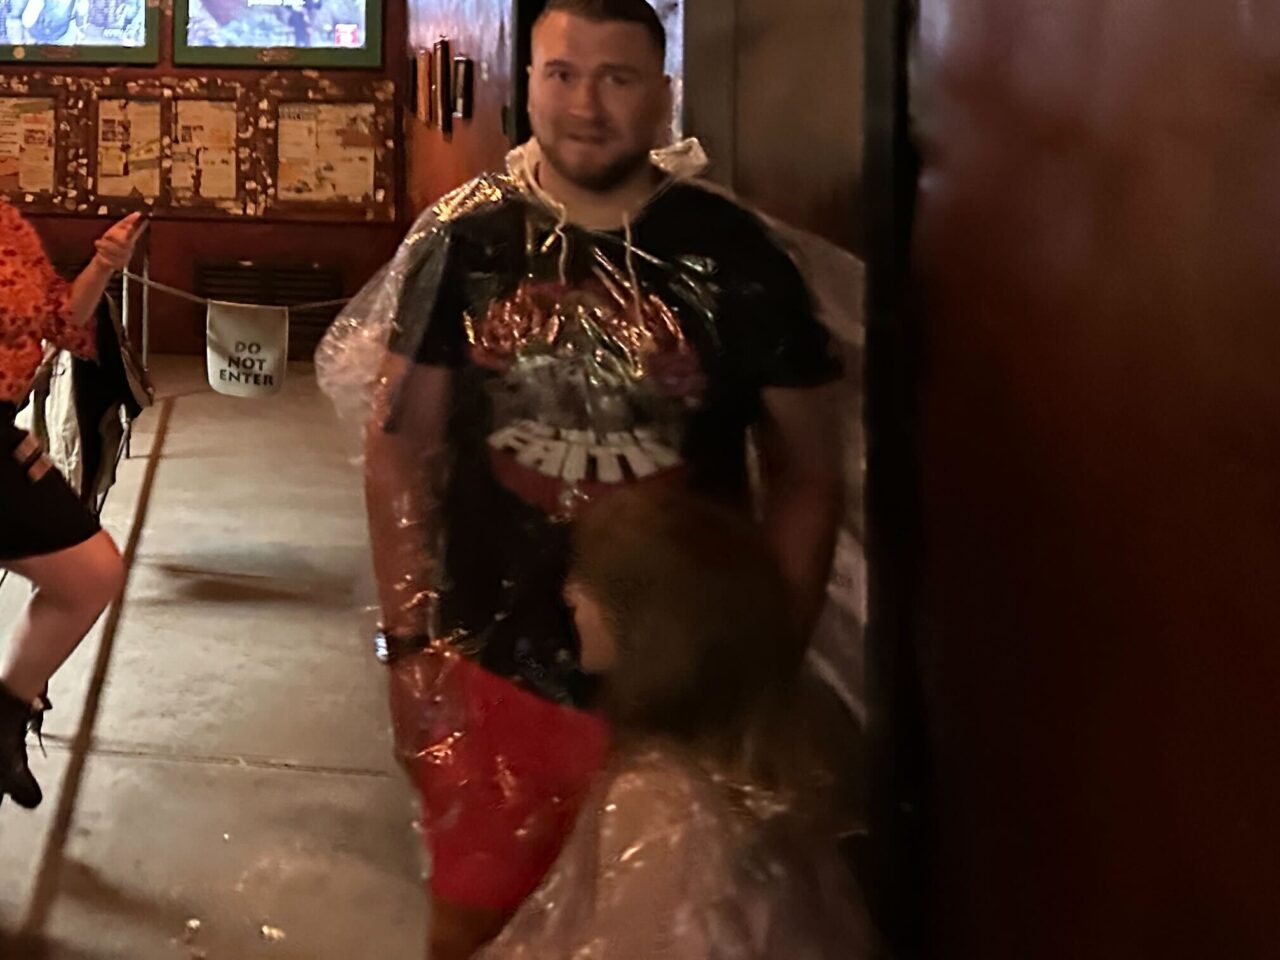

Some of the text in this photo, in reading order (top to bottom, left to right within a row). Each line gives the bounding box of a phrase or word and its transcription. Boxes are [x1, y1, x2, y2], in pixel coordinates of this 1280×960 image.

[234, 341, 261, 354] DO
[228, 356, 266, 371] NOT
[219, 369, 273, 386] ENTER
